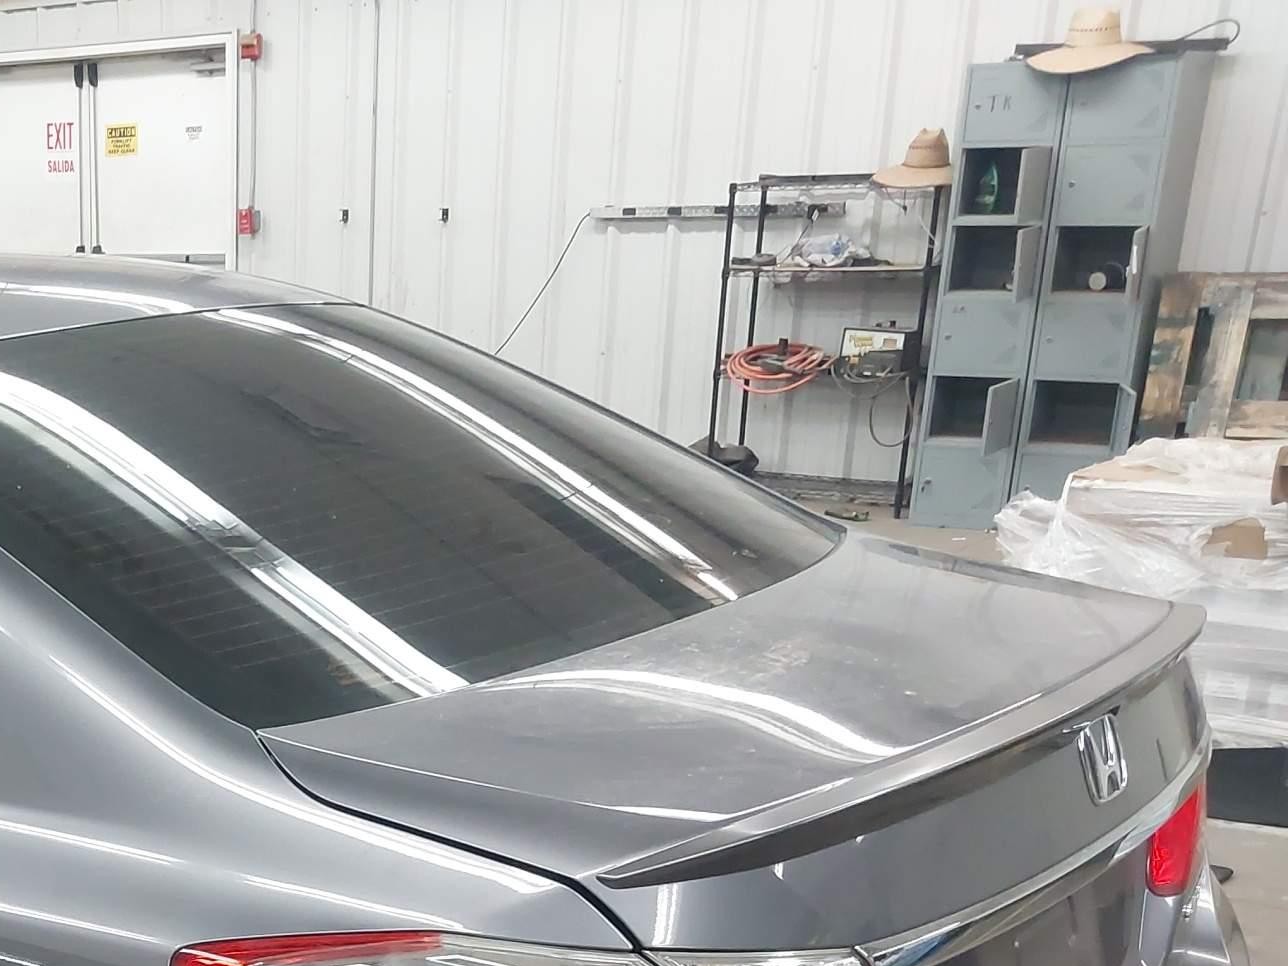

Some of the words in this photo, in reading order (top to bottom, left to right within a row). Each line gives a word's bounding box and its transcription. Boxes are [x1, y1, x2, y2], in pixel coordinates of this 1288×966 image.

[46, 122, 74, 150] EXIT
[107, 127, 136, 138] CAUTION
[47, 160, 75, 173] SALIDA
